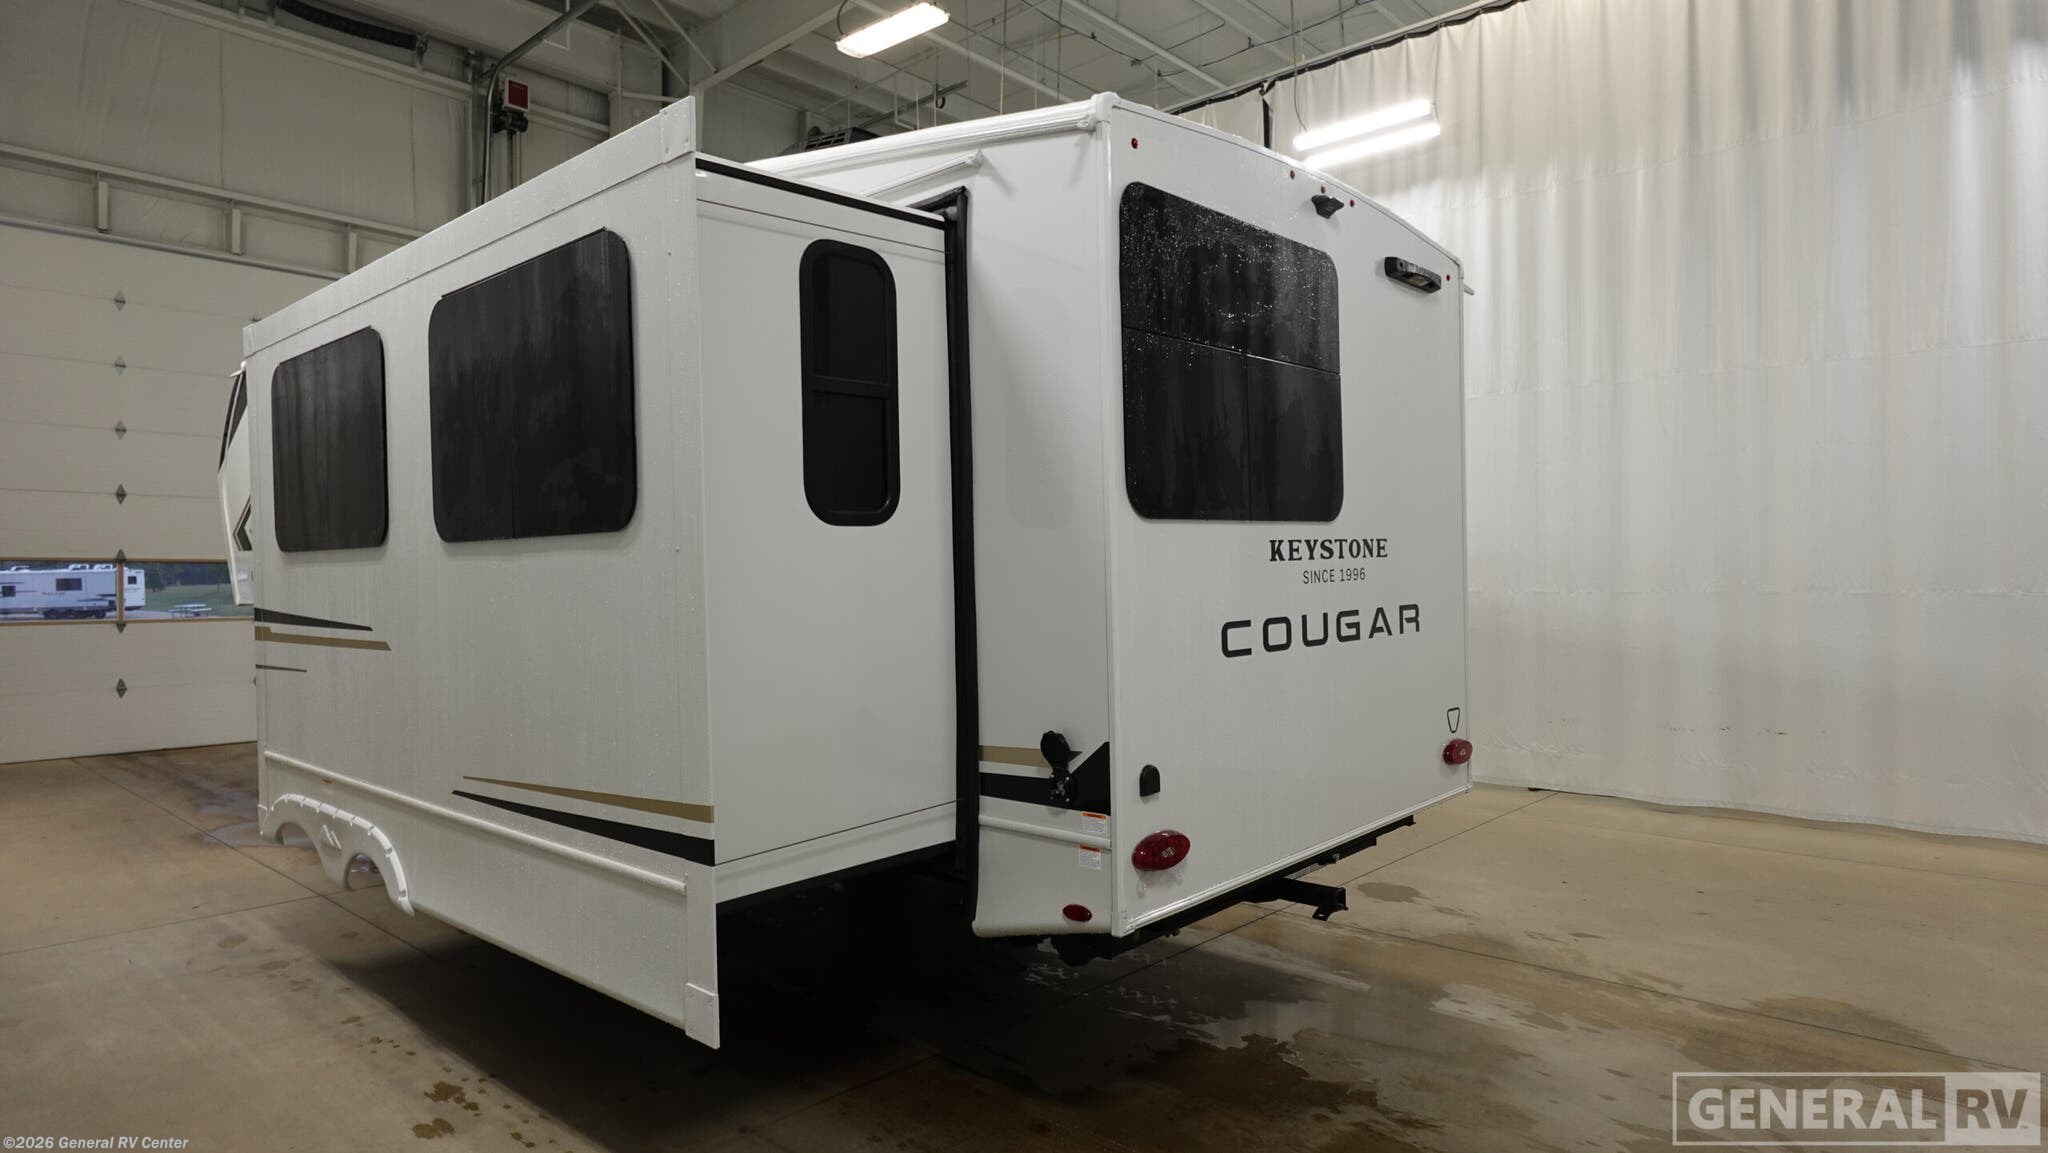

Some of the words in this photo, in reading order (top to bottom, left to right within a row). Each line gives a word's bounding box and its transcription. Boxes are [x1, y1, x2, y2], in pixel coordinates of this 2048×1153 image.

[1268, 538, 1388, 562] KEYSTONE
[1302, 568, 1336, 585] SINCE
[1339, 567, 1366, 582] 1996
[1220, 603, 1420, 659] COUGAR
